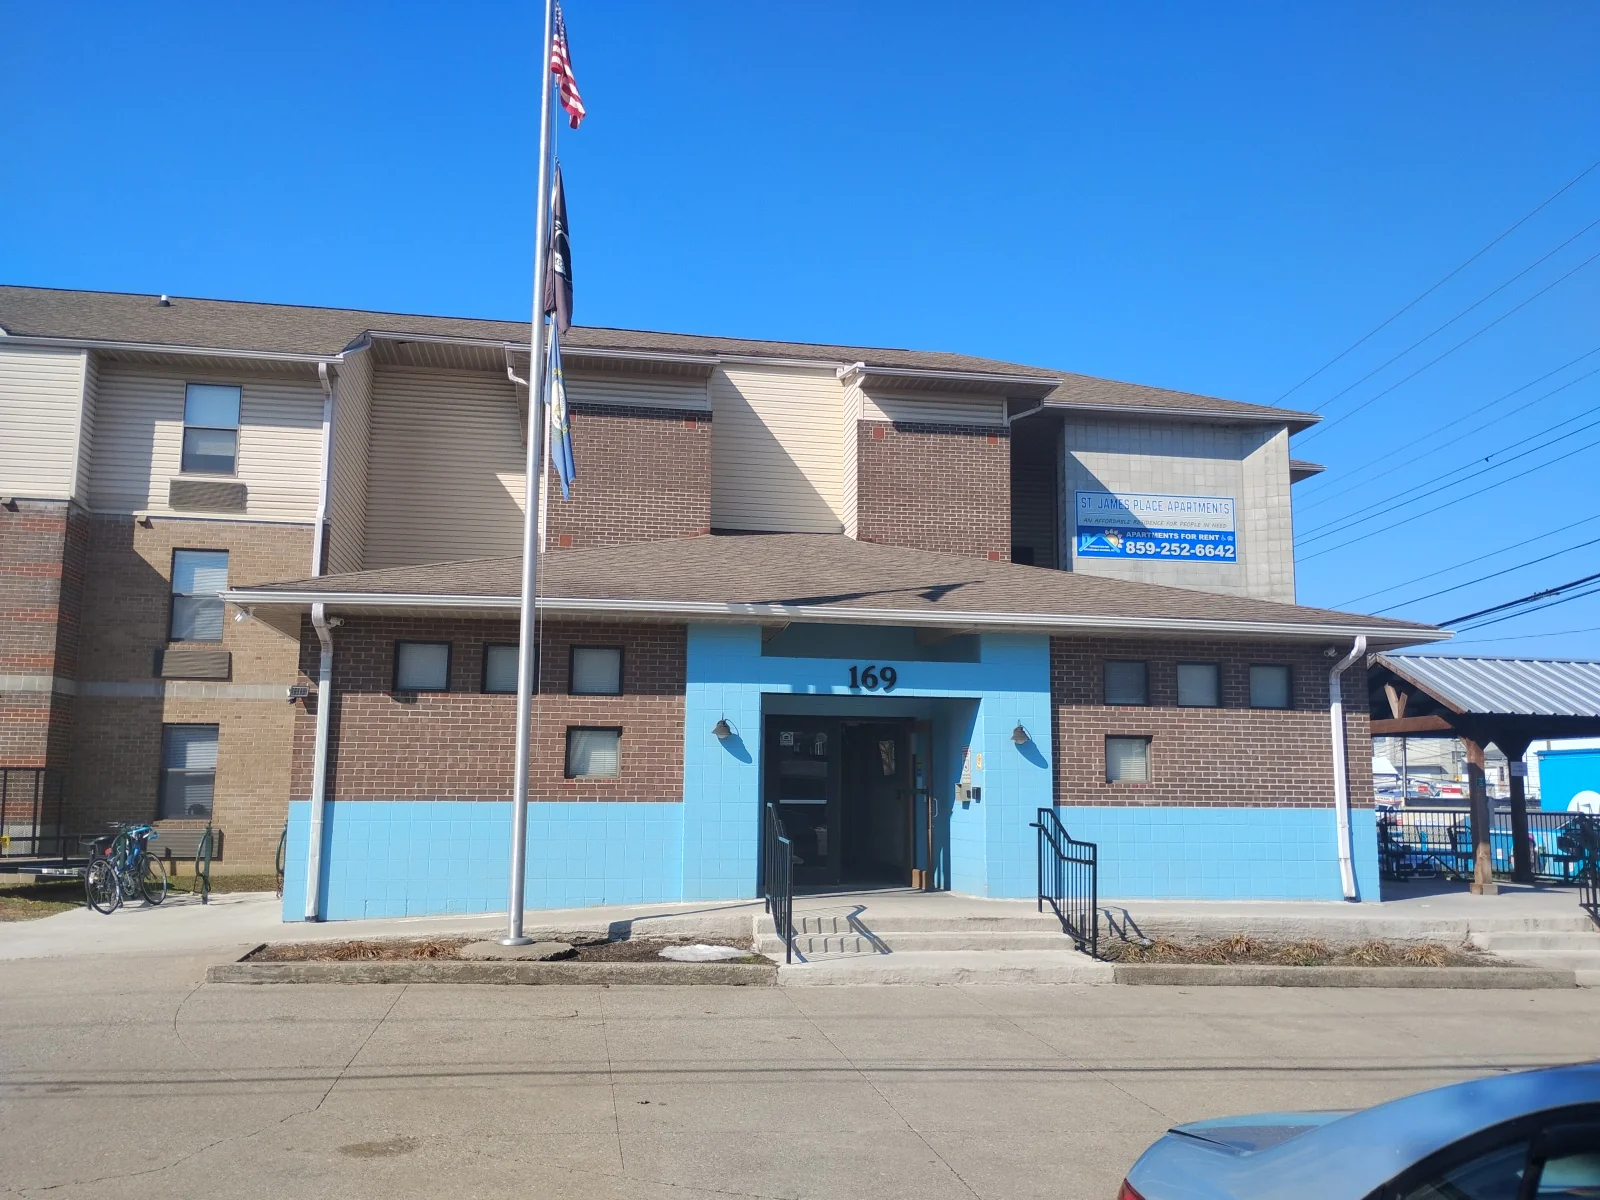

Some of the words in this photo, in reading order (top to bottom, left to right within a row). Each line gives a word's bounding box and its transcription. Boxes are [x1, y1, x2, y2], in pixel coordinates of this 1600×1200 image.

[1098, 497, 1130, 510] JAMES
[1133, 499, 1164, 512] PLACE
[1167, 500, 1230, 515] APARTMENTS
[1126, 531, 1179, 540] APARTMENTS
[1125, 541, 1235, 558] 859-252-6642
[848, 665, 897, 691] 169
